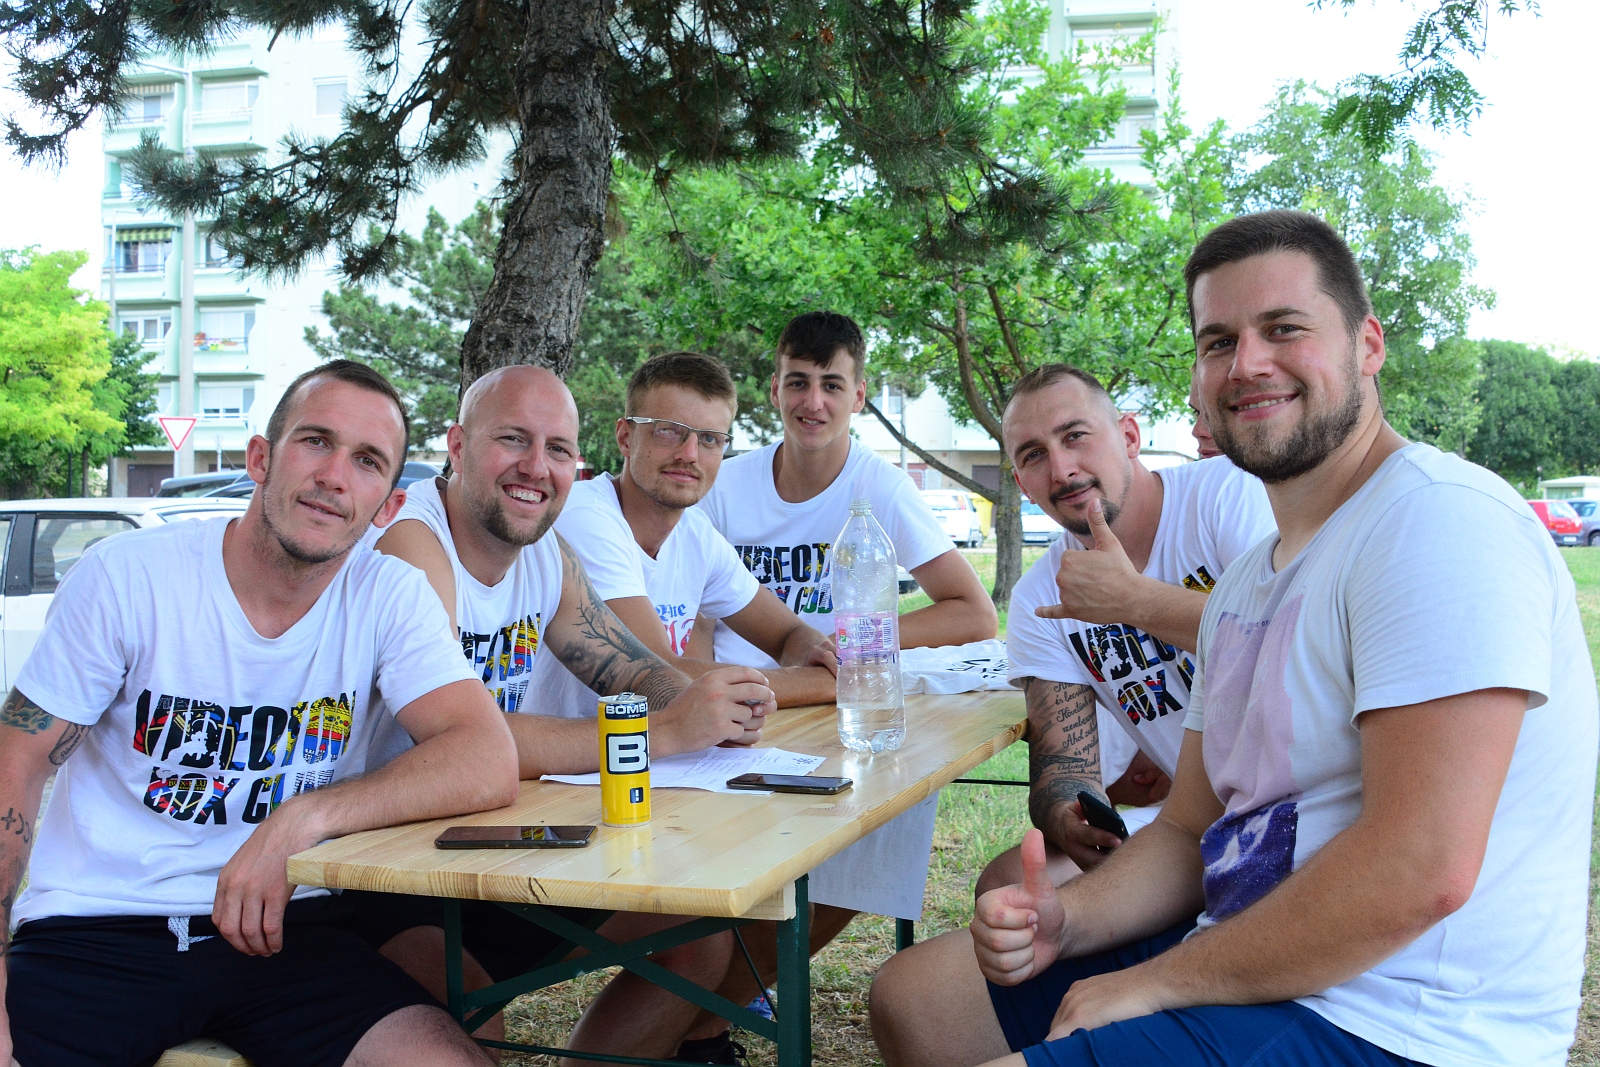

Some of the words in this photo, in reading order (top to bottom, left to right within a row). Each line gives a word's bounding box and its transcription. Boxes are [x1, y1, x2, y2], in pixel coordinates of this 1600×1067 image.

[132, 688, 357, 771] VIDEOTON
[605, 702, 648, 715] BOMB
[143, 766, 241, 825] BOX
